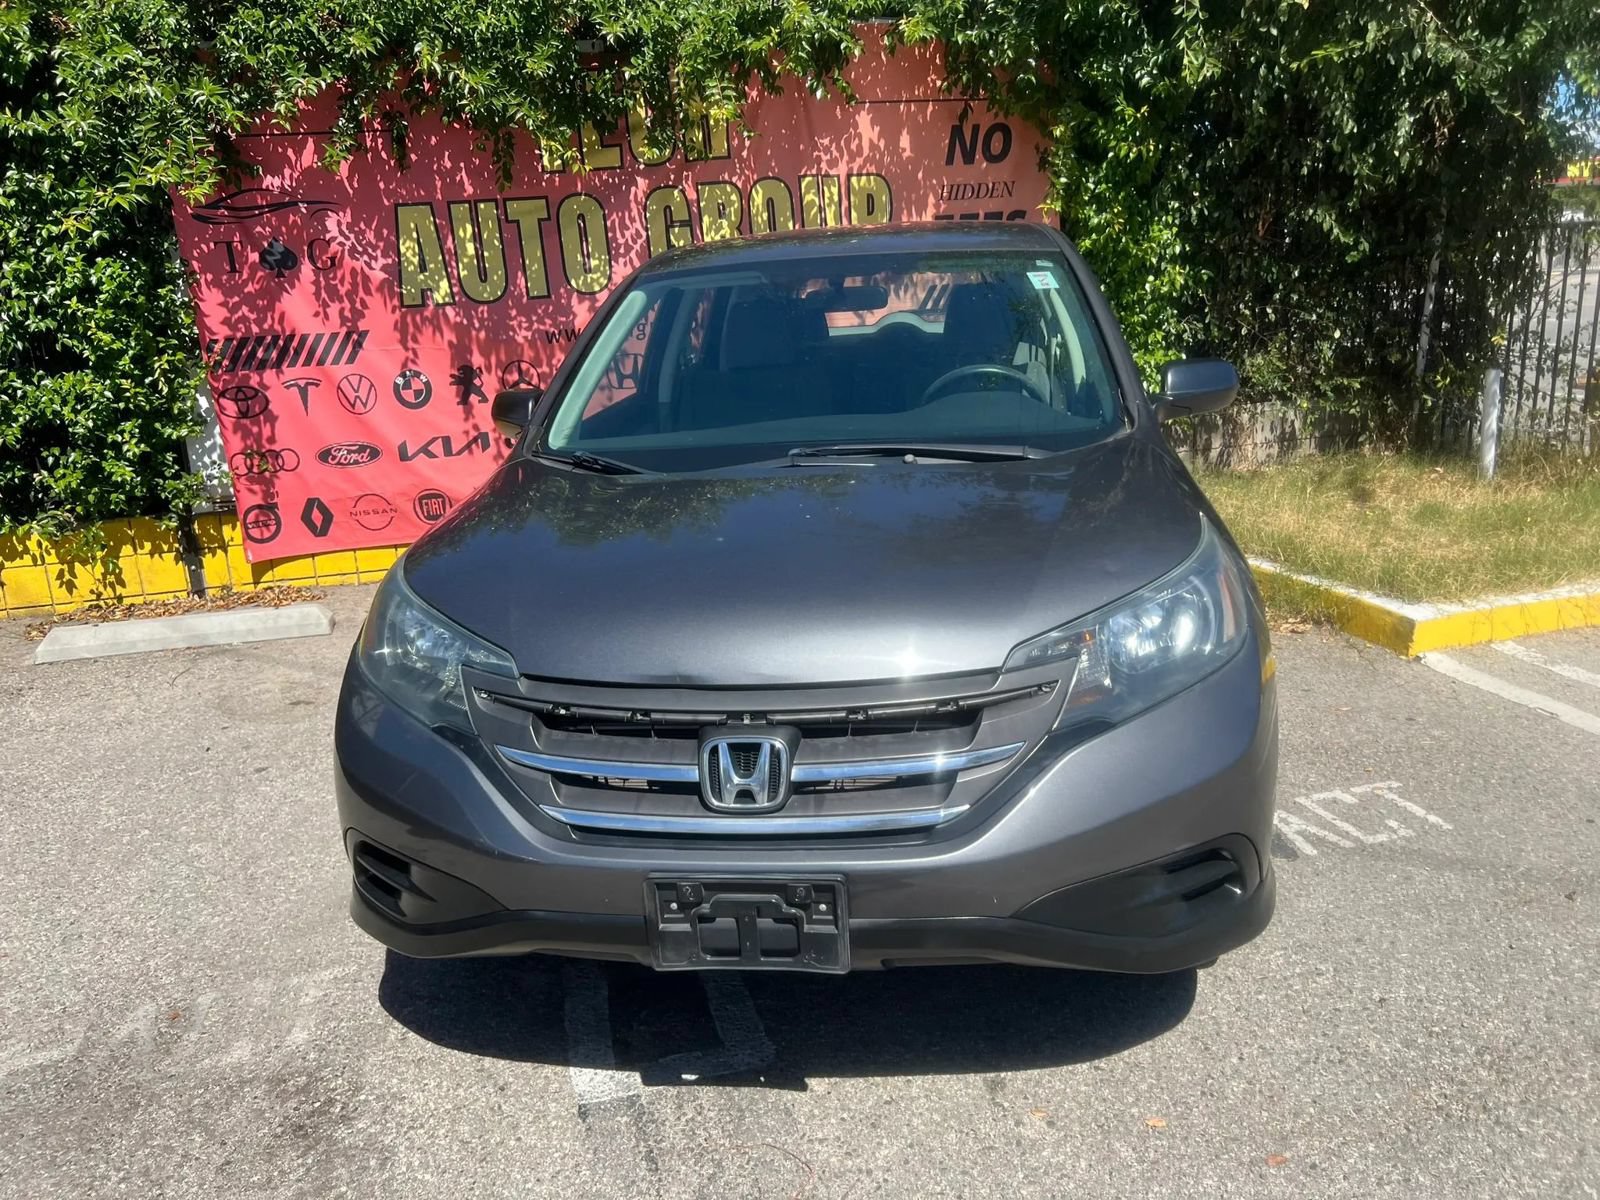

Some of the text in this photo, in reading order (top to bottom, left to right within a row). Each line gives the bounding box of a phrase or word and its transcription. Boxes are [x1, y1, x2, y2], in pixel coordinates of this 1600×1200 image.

[945, 122, 1013, 167] NO
[938, 181, 1015, 201] HIDDEN
[394, 192, 612, 309] AUTO
[328, 445, 371, 465] Ford
[397, 432, 491, 462] KIA
[350, 507, 398, 518] NISSAN
[421, 498, 445, 517] FIAT
